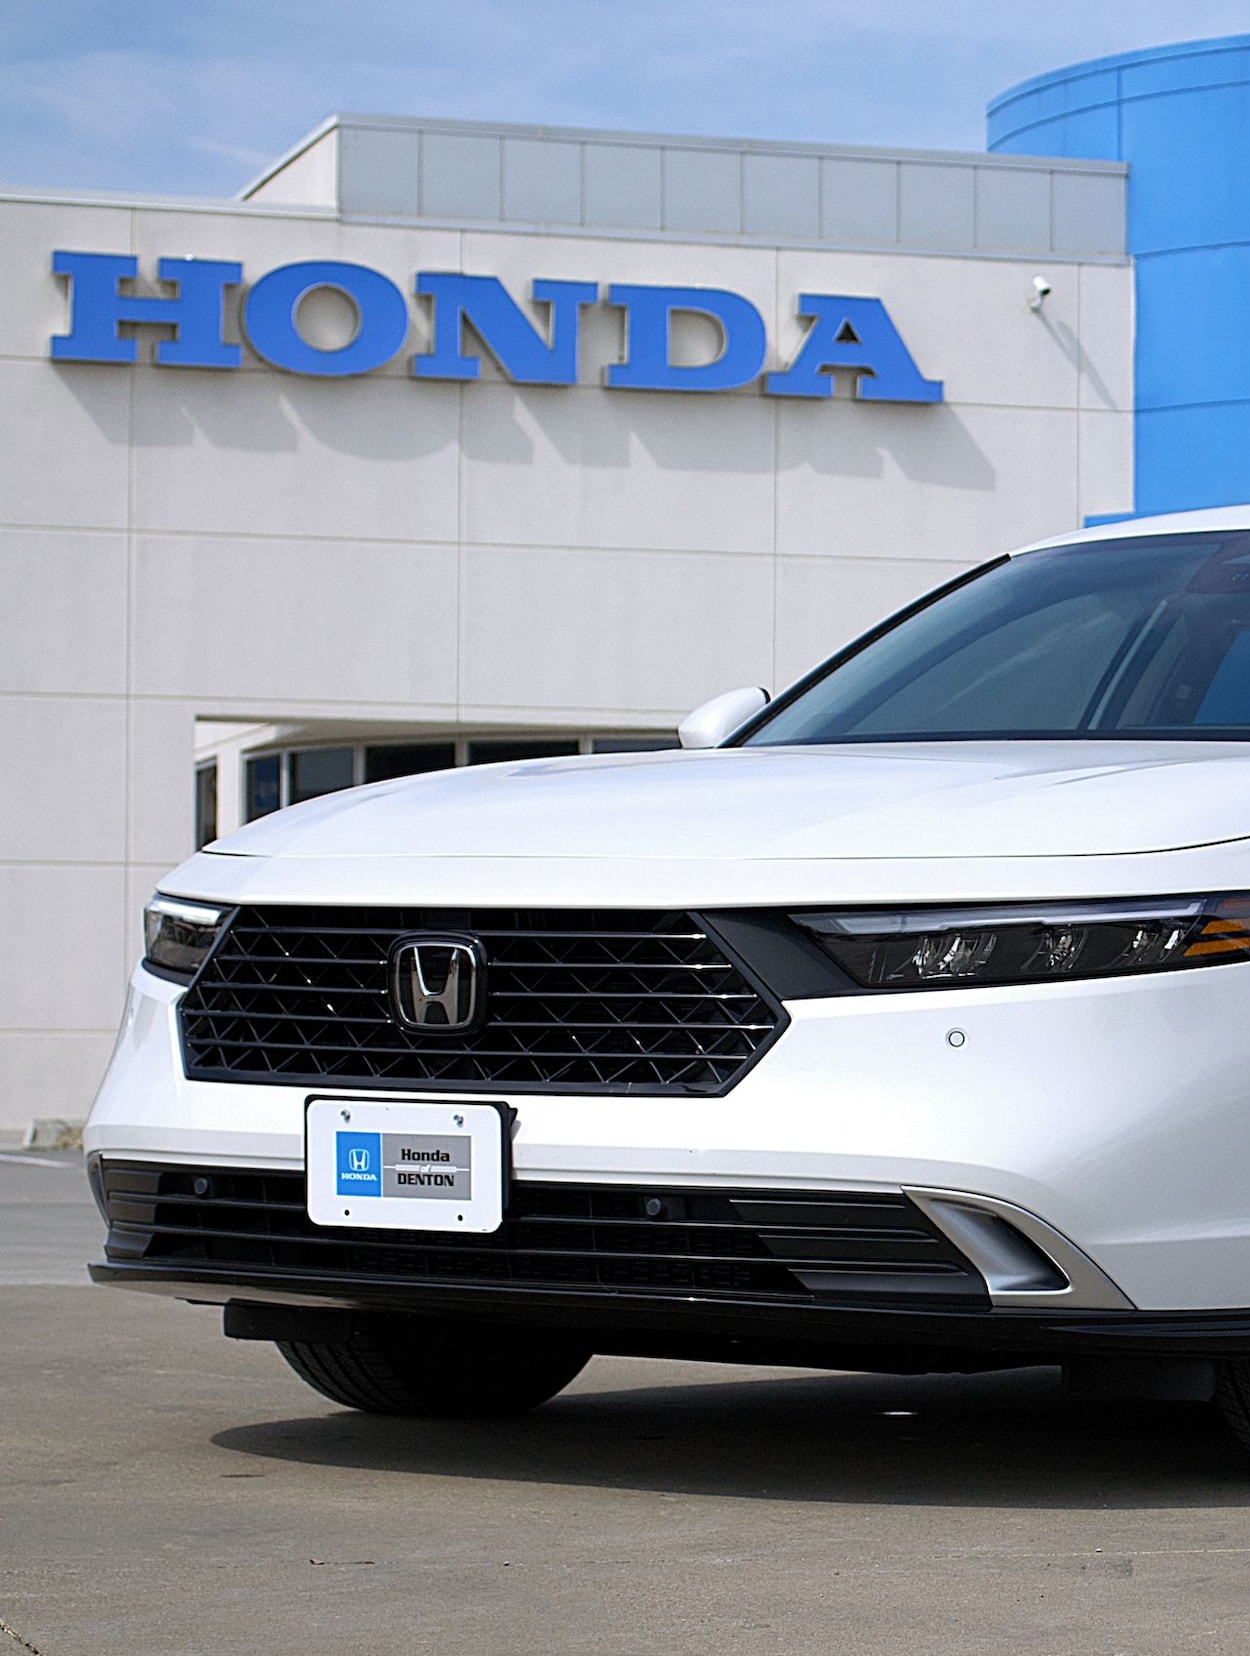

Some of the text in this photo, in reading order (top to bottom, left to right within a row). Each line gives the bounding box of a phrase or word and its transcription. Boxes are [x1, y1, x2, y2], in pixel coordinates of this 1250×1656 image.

[51, 250, 944, 402] HONDA
[401, 1148, 450, 1162] Honda
[341, 1172, 377, 1181] HONDA
[397, 1173, 454, 1187] DENTON
